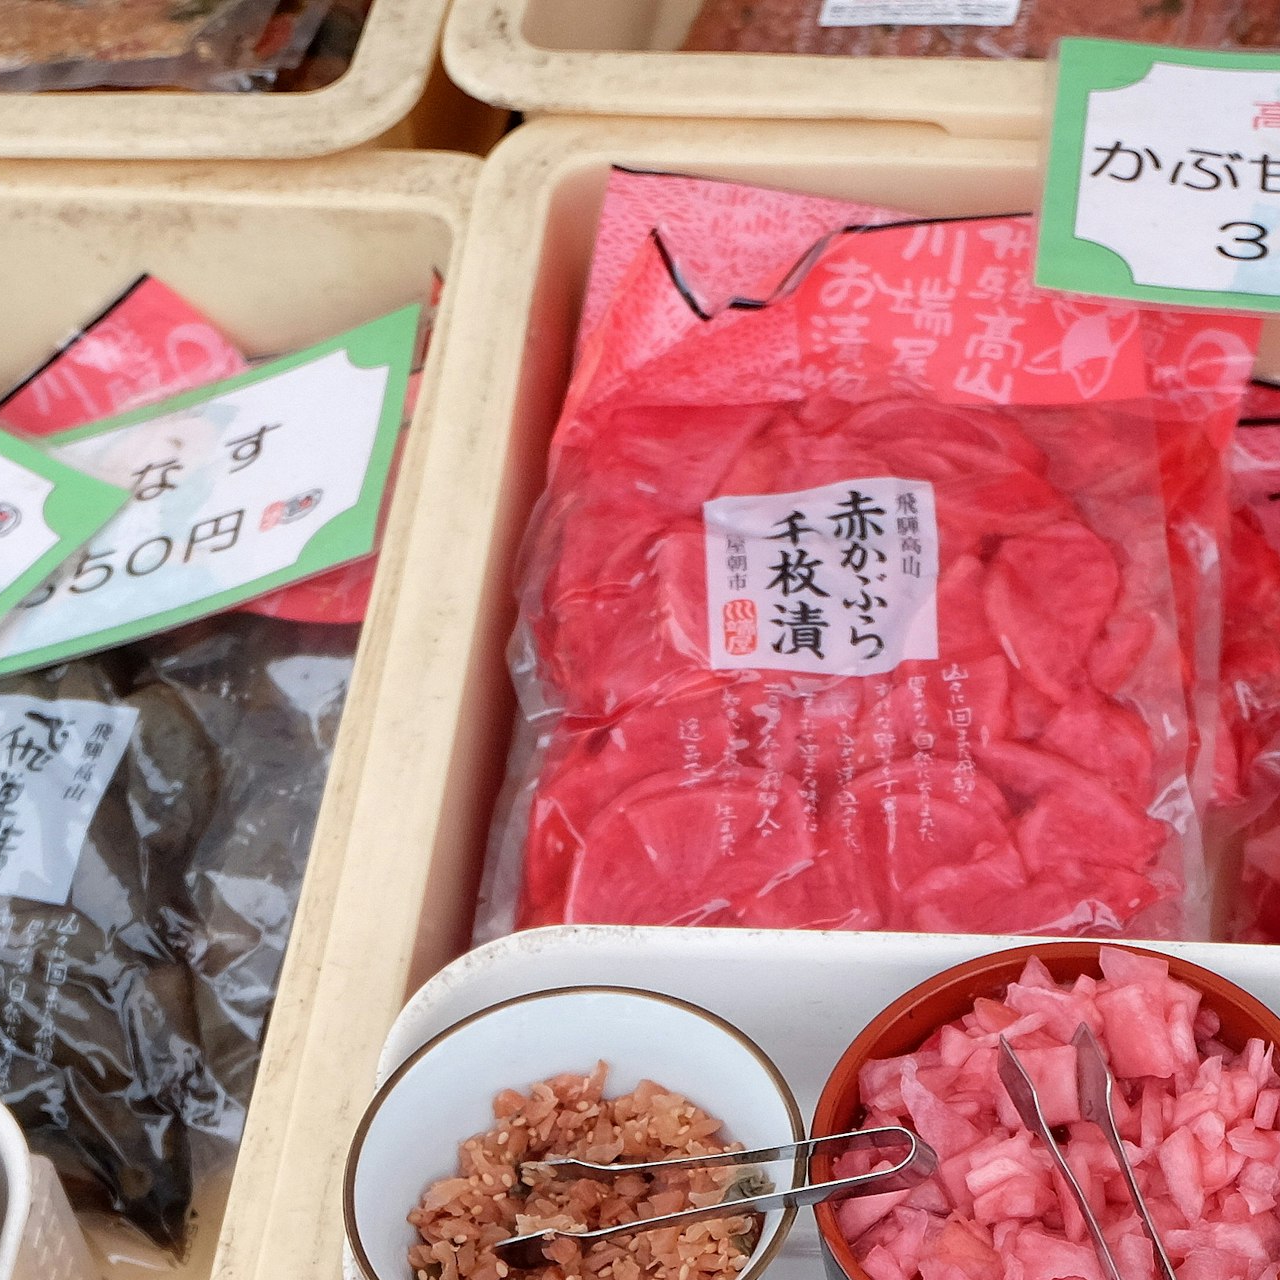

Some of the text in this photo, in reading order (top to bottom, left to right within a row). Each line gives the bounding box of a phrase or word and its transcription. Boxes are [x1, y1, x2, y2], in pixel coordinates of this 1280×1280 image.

[763, 510, 830, 660] 千枚漬
[826, 490, 888, 659] 赤かぶら
[895, 492, 922, 578] 飛騨高山
